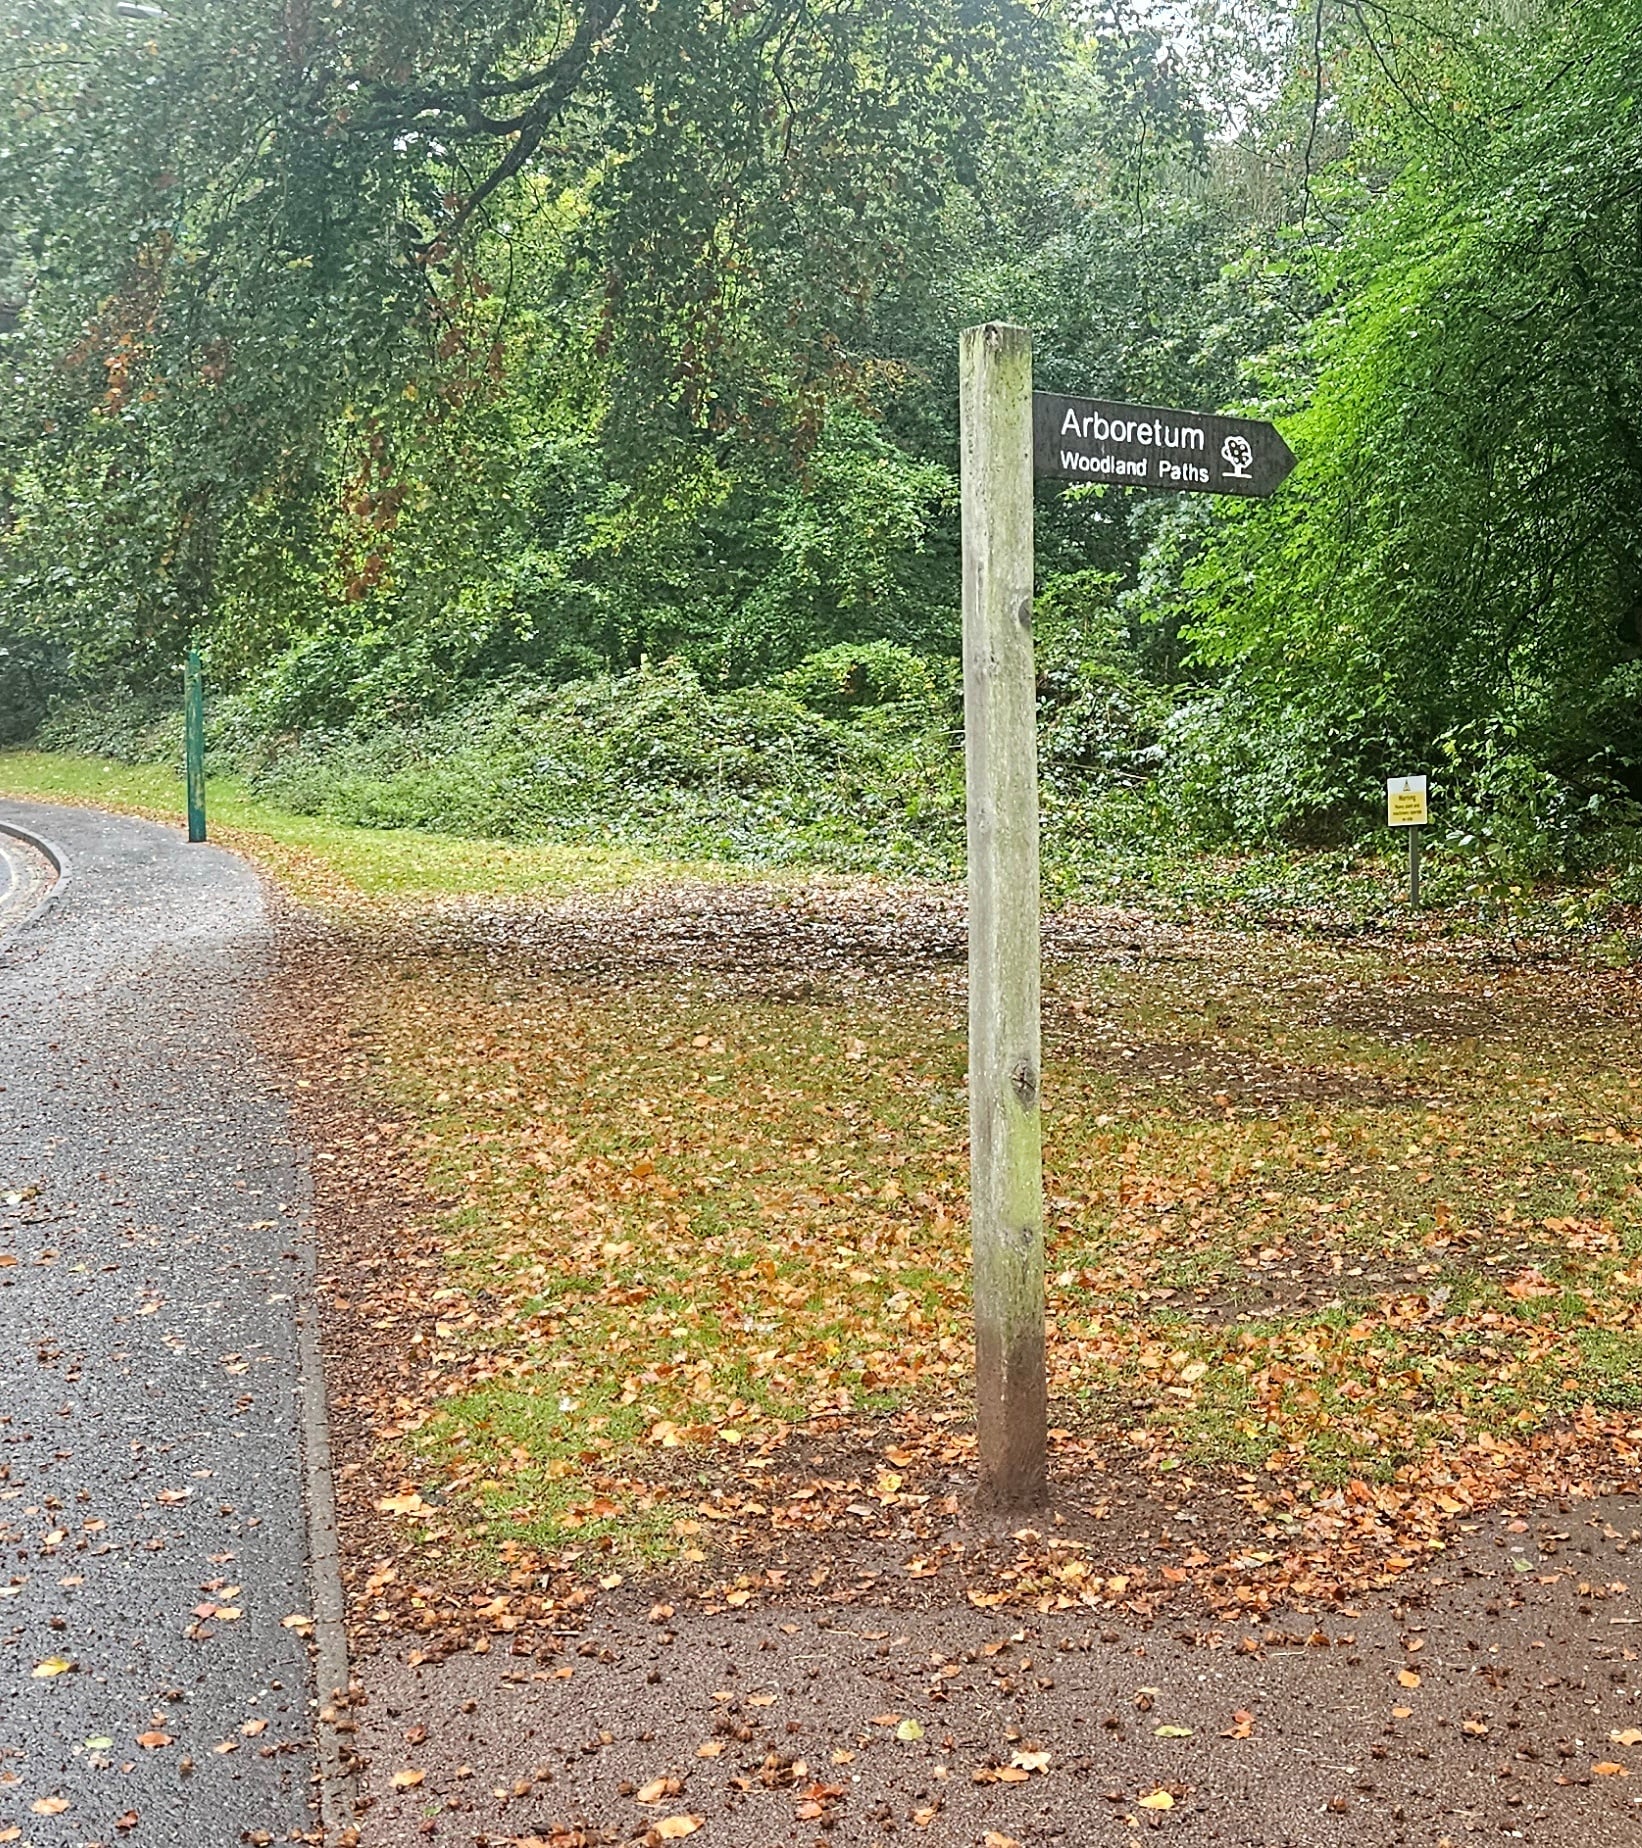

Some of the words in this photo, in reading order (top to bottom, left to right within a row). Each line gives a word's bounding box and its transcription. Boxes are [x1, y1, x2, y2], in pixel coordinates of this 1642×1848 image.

[1061, 408, 1204, 450] Arboretum
[1060, 450, 1147, 477] Woodland
[1158, 460, 1209, 483] Paths
